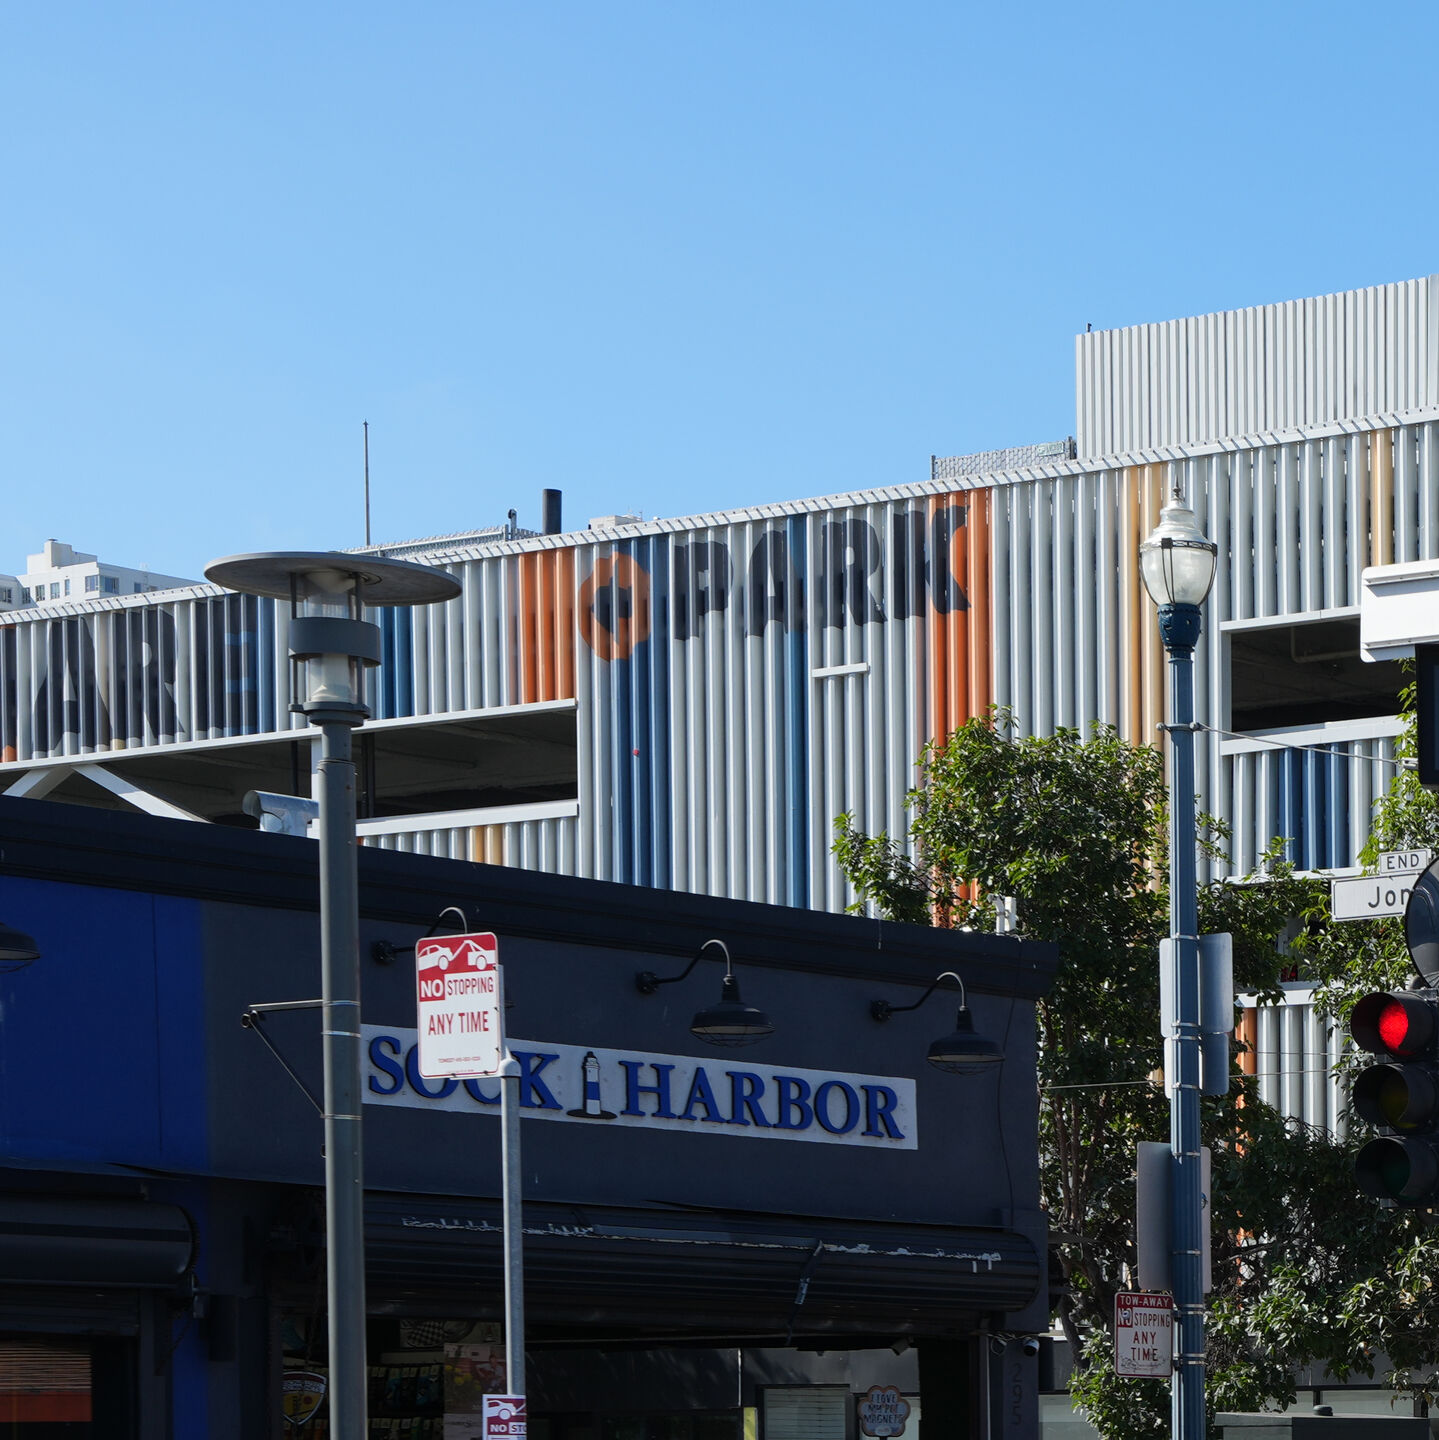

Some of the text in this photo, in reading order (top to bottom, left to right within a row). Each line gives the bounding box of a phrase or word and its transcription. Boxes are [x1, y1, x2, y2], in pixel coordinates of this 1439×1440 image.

[674, 504, 974, 642] PARK
[1387, 853, 1420, 870] END
[1368, 885, 1414, 909] Jon
[420, 976, 494, 998] NO STOPPING
[428, 1010, 490, 1036] ANY TIME
[617, 1059, 906, 1141] HARBOR
[1120, 1295, 1170, 1308] TOW-AWAY
[1134, 1312, 1171, 1328] STOPPING
[1132, 1331, 1157, 1345] ANY
[1130, 1347, 1159, 1362] TIME
[1011, 1362, 1023, 1426] 295
[489, 1424, 507, 1433] NO
